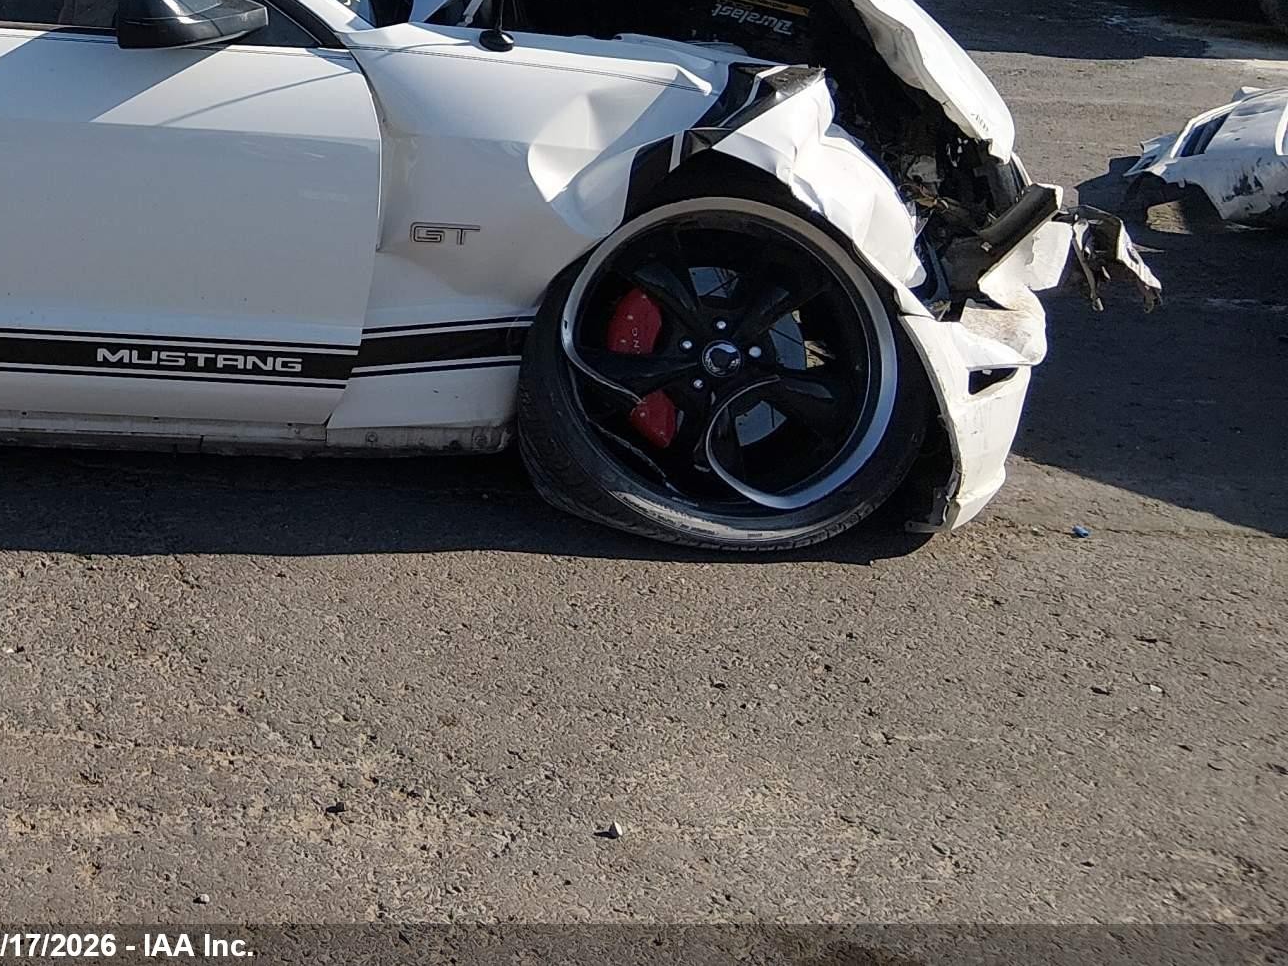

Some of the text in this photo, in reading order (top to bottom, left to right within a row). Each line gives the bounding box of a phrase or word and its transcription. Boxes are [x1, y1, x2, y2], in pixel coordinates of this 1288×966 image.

[711, 3, 793, 35] Duralast
[410, 222, 480, 245] GT
[97, 348, 302, 372] MUSTANG
